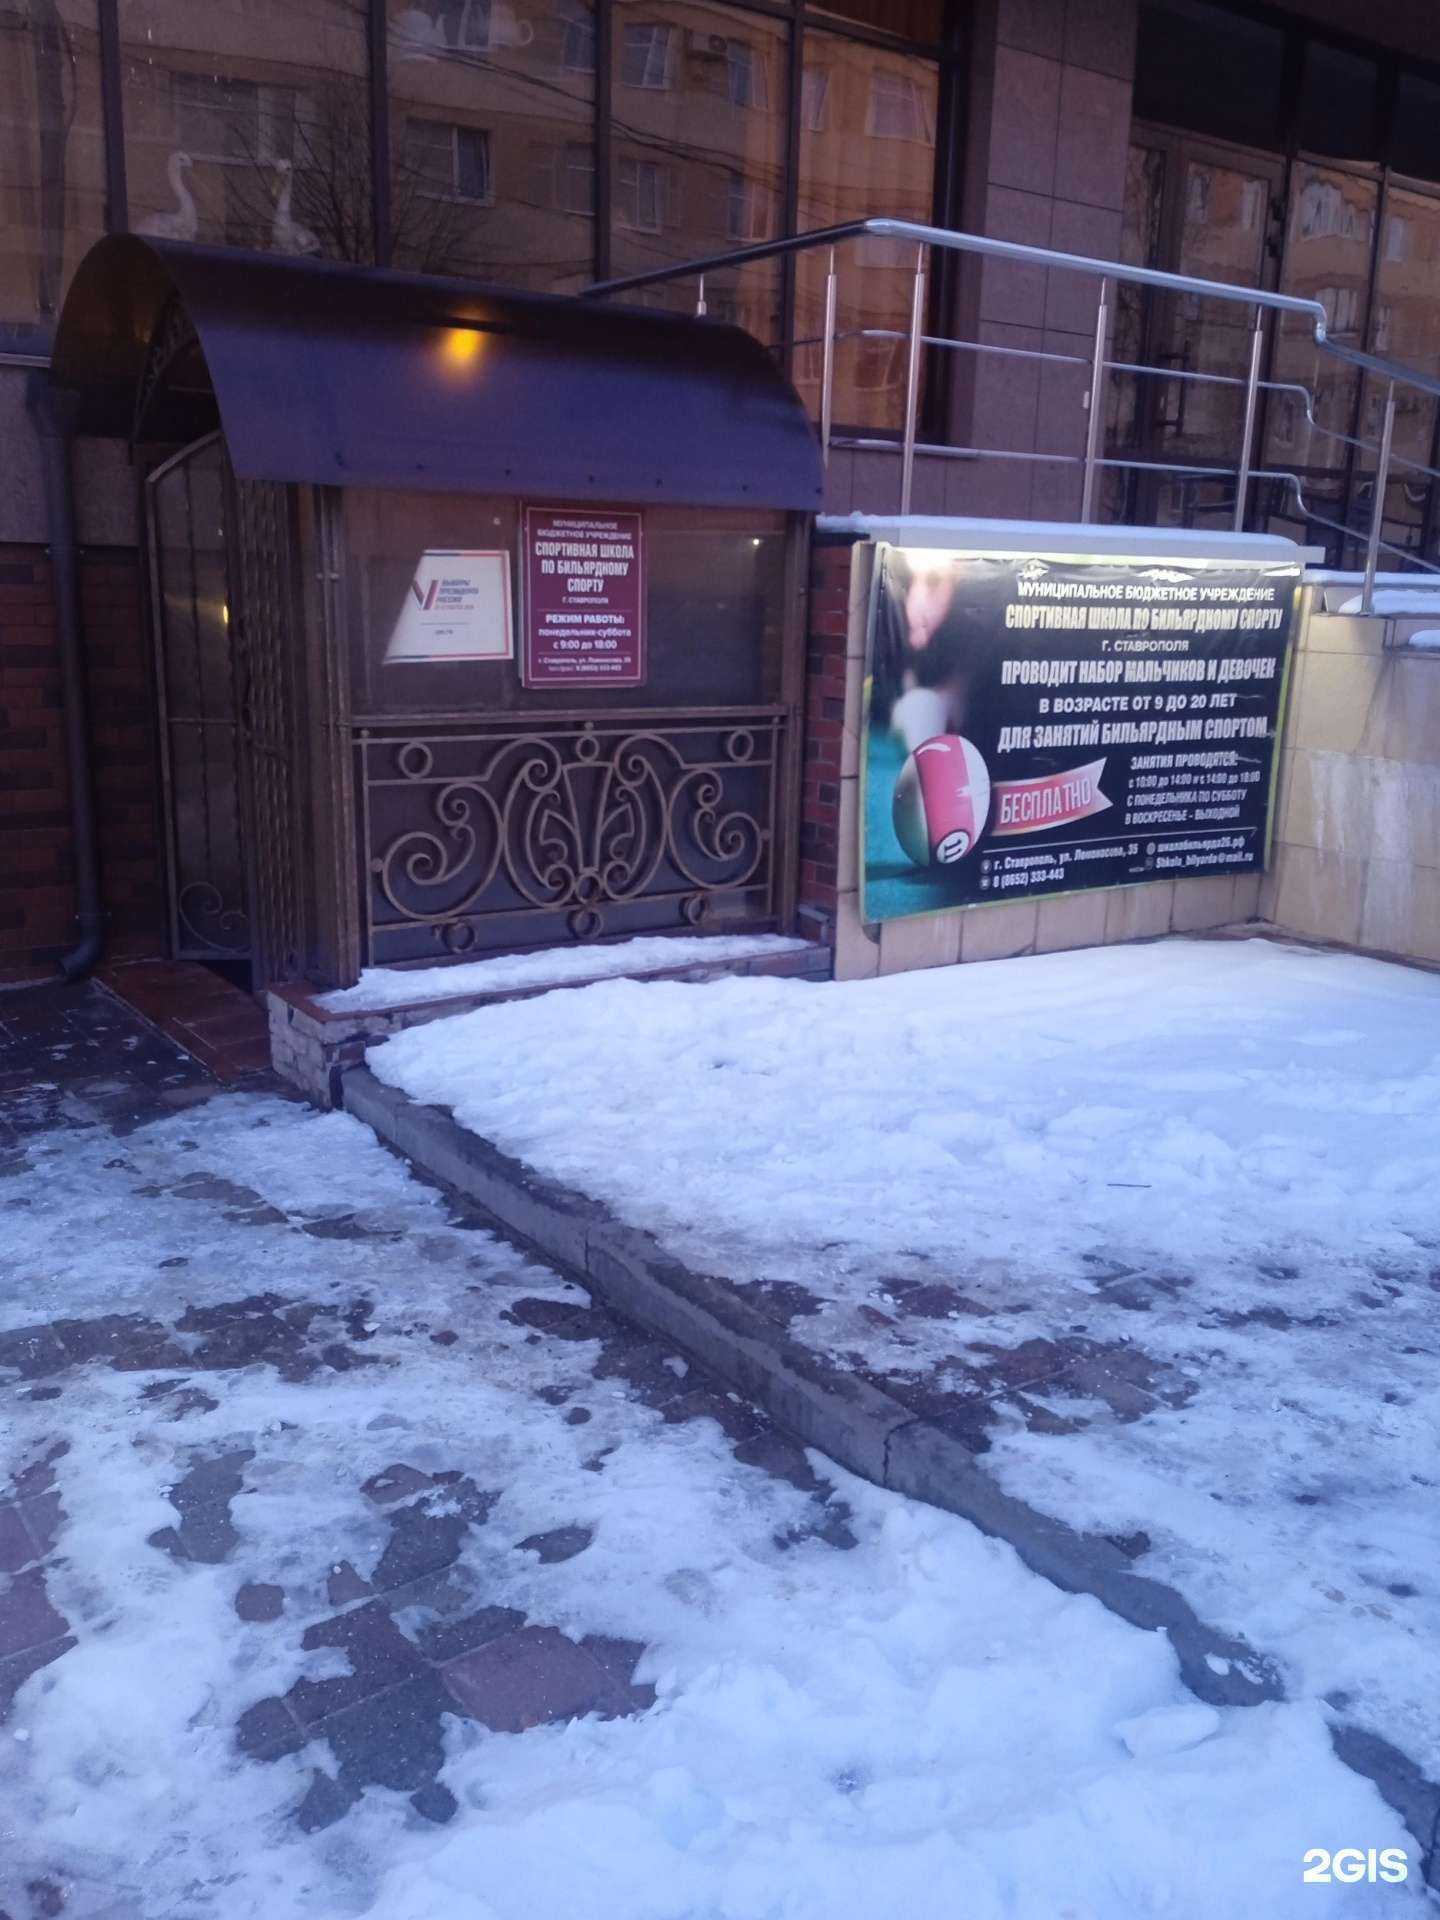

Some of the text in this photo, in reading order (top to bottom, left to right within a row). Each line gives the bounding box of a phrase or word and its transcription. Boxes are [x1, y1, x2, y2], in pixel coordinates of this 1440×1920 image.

[535, 542, 634, 558] СПОРТИВНАЯ ШКОЛА
[541, 560, 629, 577] ПО БИЛЬЯРДНОМУ
[567, 578, 604, 592] СПОРТУ
[1017, 582, 1275, 601] МУНИЦИПАЛЬНОЕ БЮДЖЕТНОЕ УЧРЕЖДЕНИЕ
[546, 614, 624, 624] РЕЖИМ РАБОТЫ:
[1005, 604, 1087, 629] СПОРТИВНАЯ
[1088, 607, 1132, 629] ШКОЛА
[1150, 607, 1238, 632] БИЛЬЯРДНОМУ
[1239, 608, 1283, 629] СПОРТУ
[560, 640, 580, 649] 9:00
[581, 642, 593, 650] до
[594, 640, 618, 649] 18:00
[1101, 640, 1189, 652] Г. СТАВРОПОЛЯ
[1001, 658, 1276, 686] ПРОВОДИТ НАБОР МАЛЬЧИКОВ И ДЕВОЧЕК
[1039, 693, 1237, 713] В ВОЗРАСТЕ ОТ 9 ДО 20 ЛЕТ
[998, 727, 1031, 753] ДЛЯ
[1033, 720, 1100, 748] ЗАНЯТИЙ
[1101, 720, 1203, 745] БИЛЬЯРДНЫМ
[1130, 750, 1239, 770] ЗАНЯТИЯ ПРОВОДЯТСЯ:
[1157, 776, 1169, 788] до
[1228, 774, 1239, 785] до
[1000, 777, 1091, 825] БЕСПЛАТНО
[1126, 789, 1247, 807] С ПОНЕДЕЛЬНИКА ПО СУББОТУ
[1124, 813, 1131, 825] В
[1132, 809, 1187, 824] ВОСКРЕСЕНЬЕ
[1194, 804, 1240, 820] ВЫХОДНОЙ
[994, 860, 1002, 870] г.
